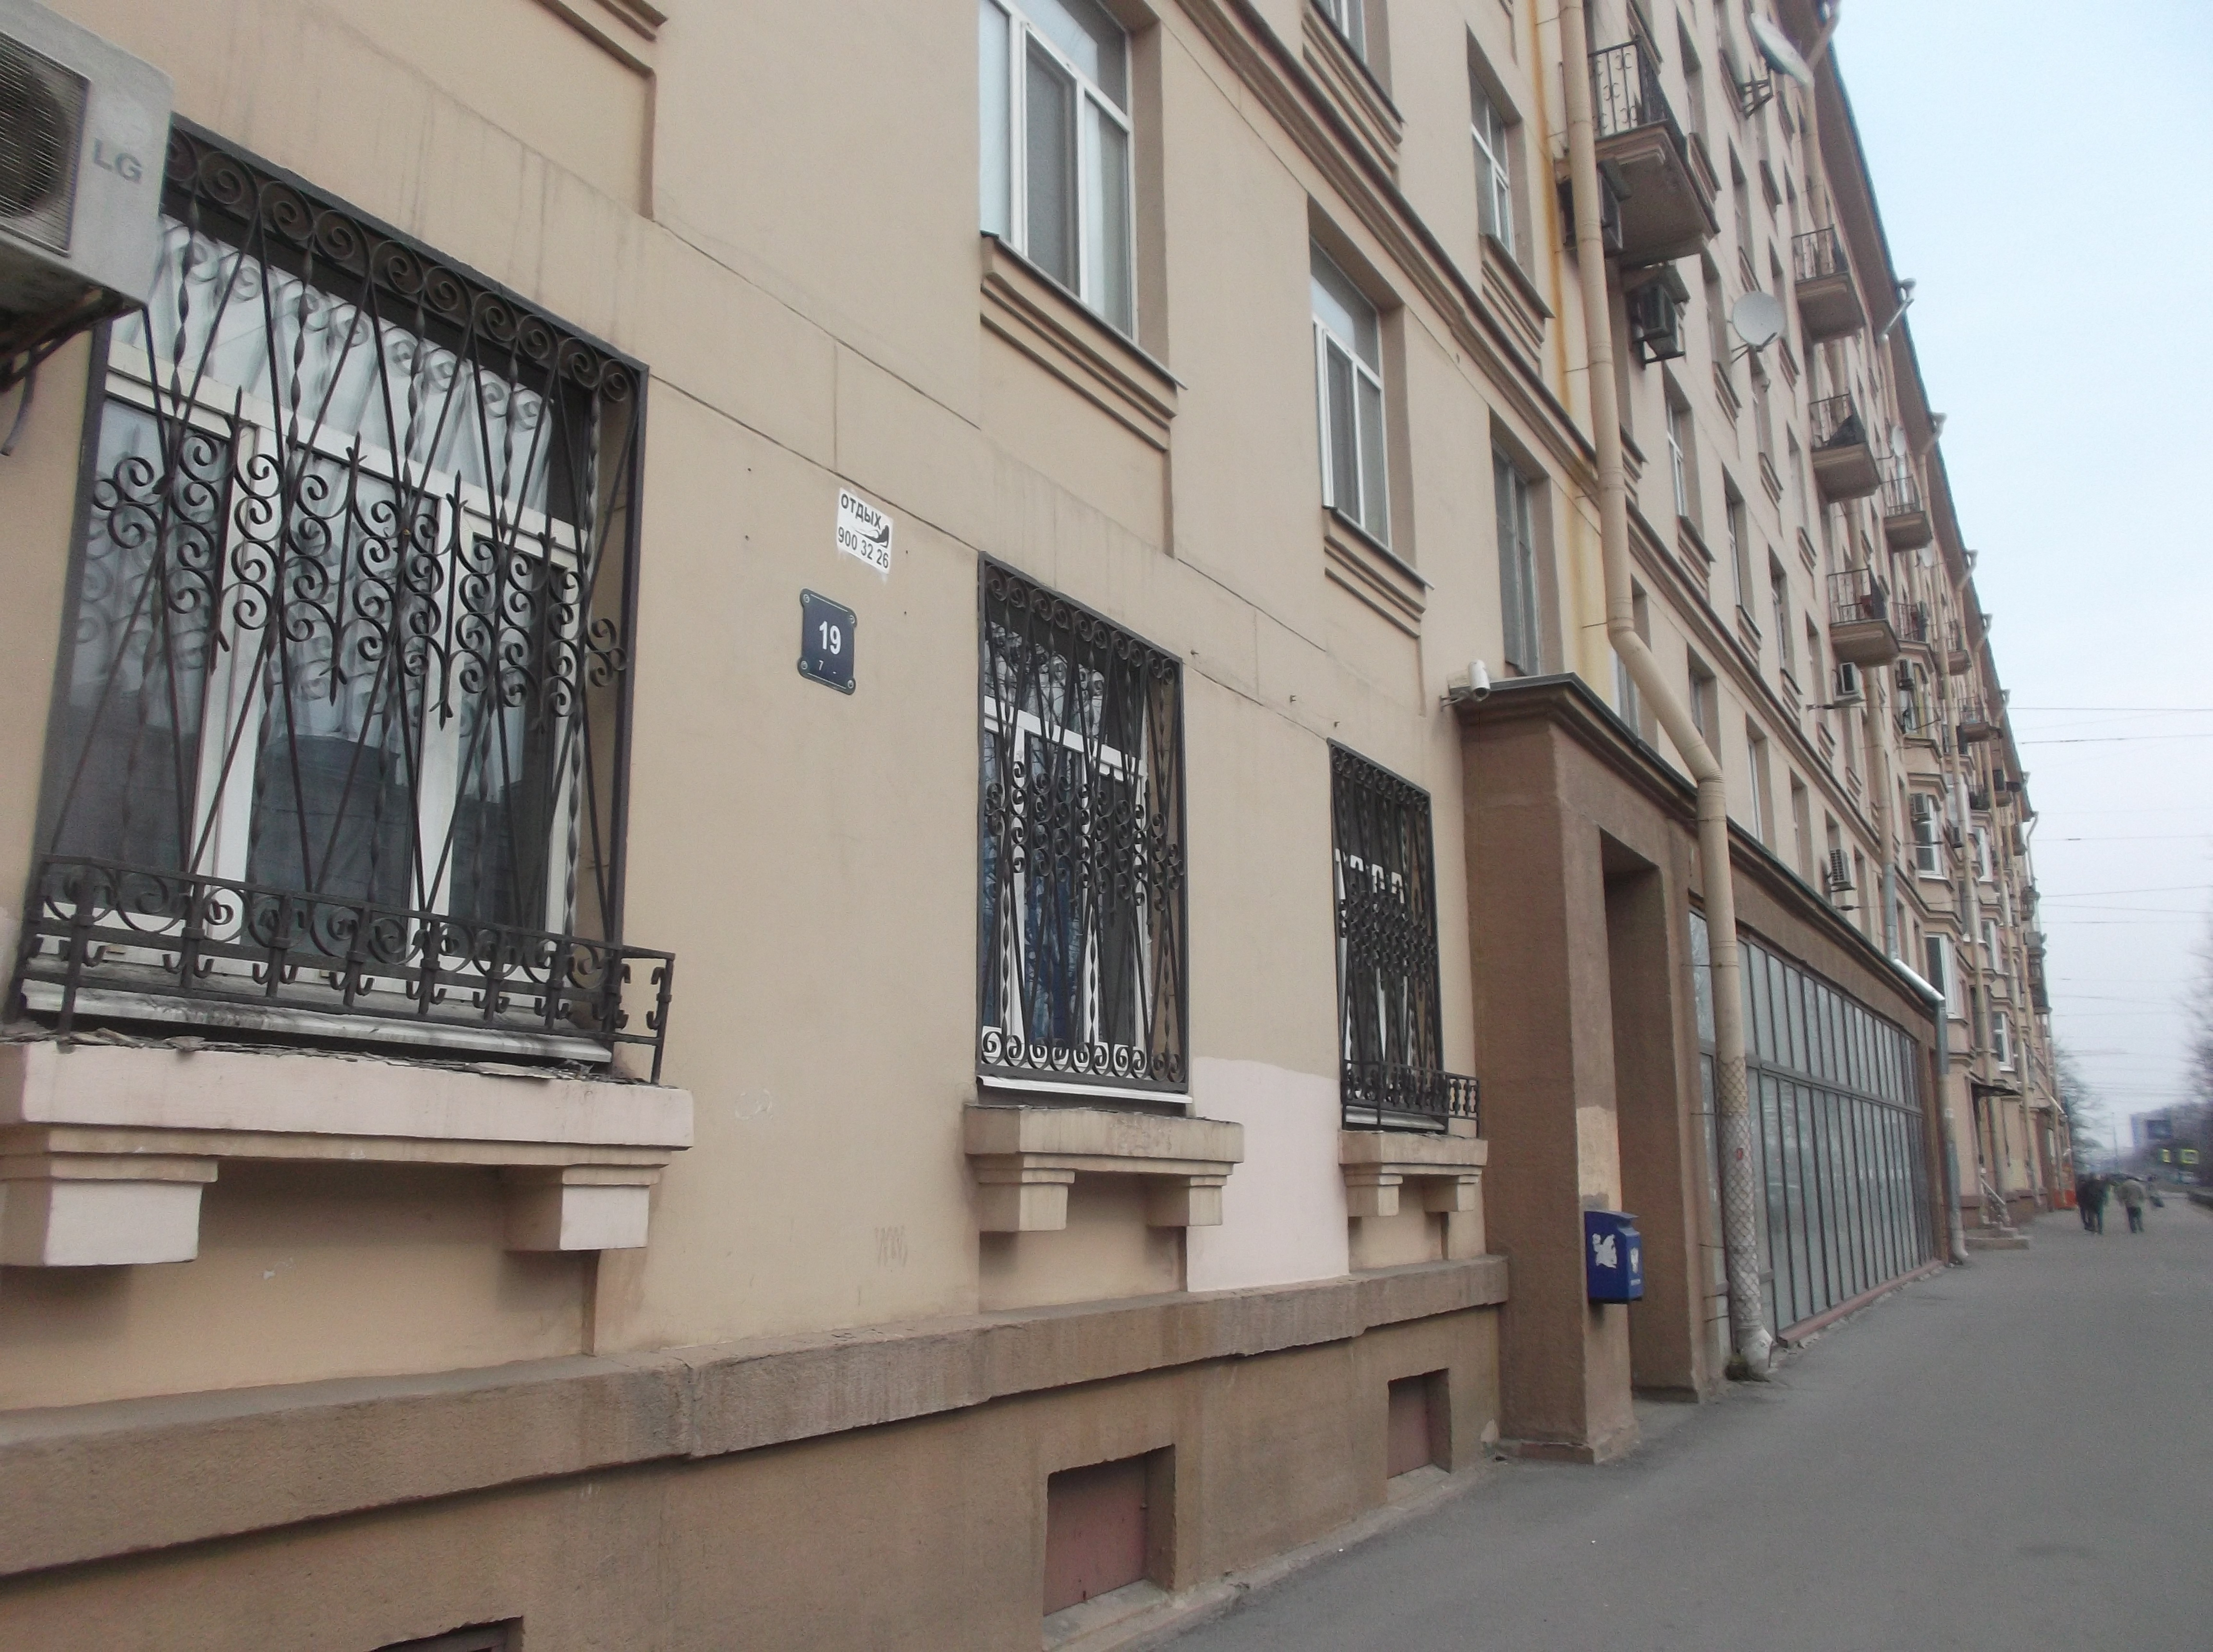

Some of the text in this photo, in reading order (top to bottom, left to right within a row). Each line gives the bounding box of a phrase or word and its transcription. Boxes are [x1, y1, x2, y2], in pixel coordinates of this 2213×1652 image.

[94, 138, 143, 184] LG
[840, 493, 882, 530] ОТДЫХ
[838, 526, 888, 569] 900 32 26
[819, 620, 841, 655] 19
